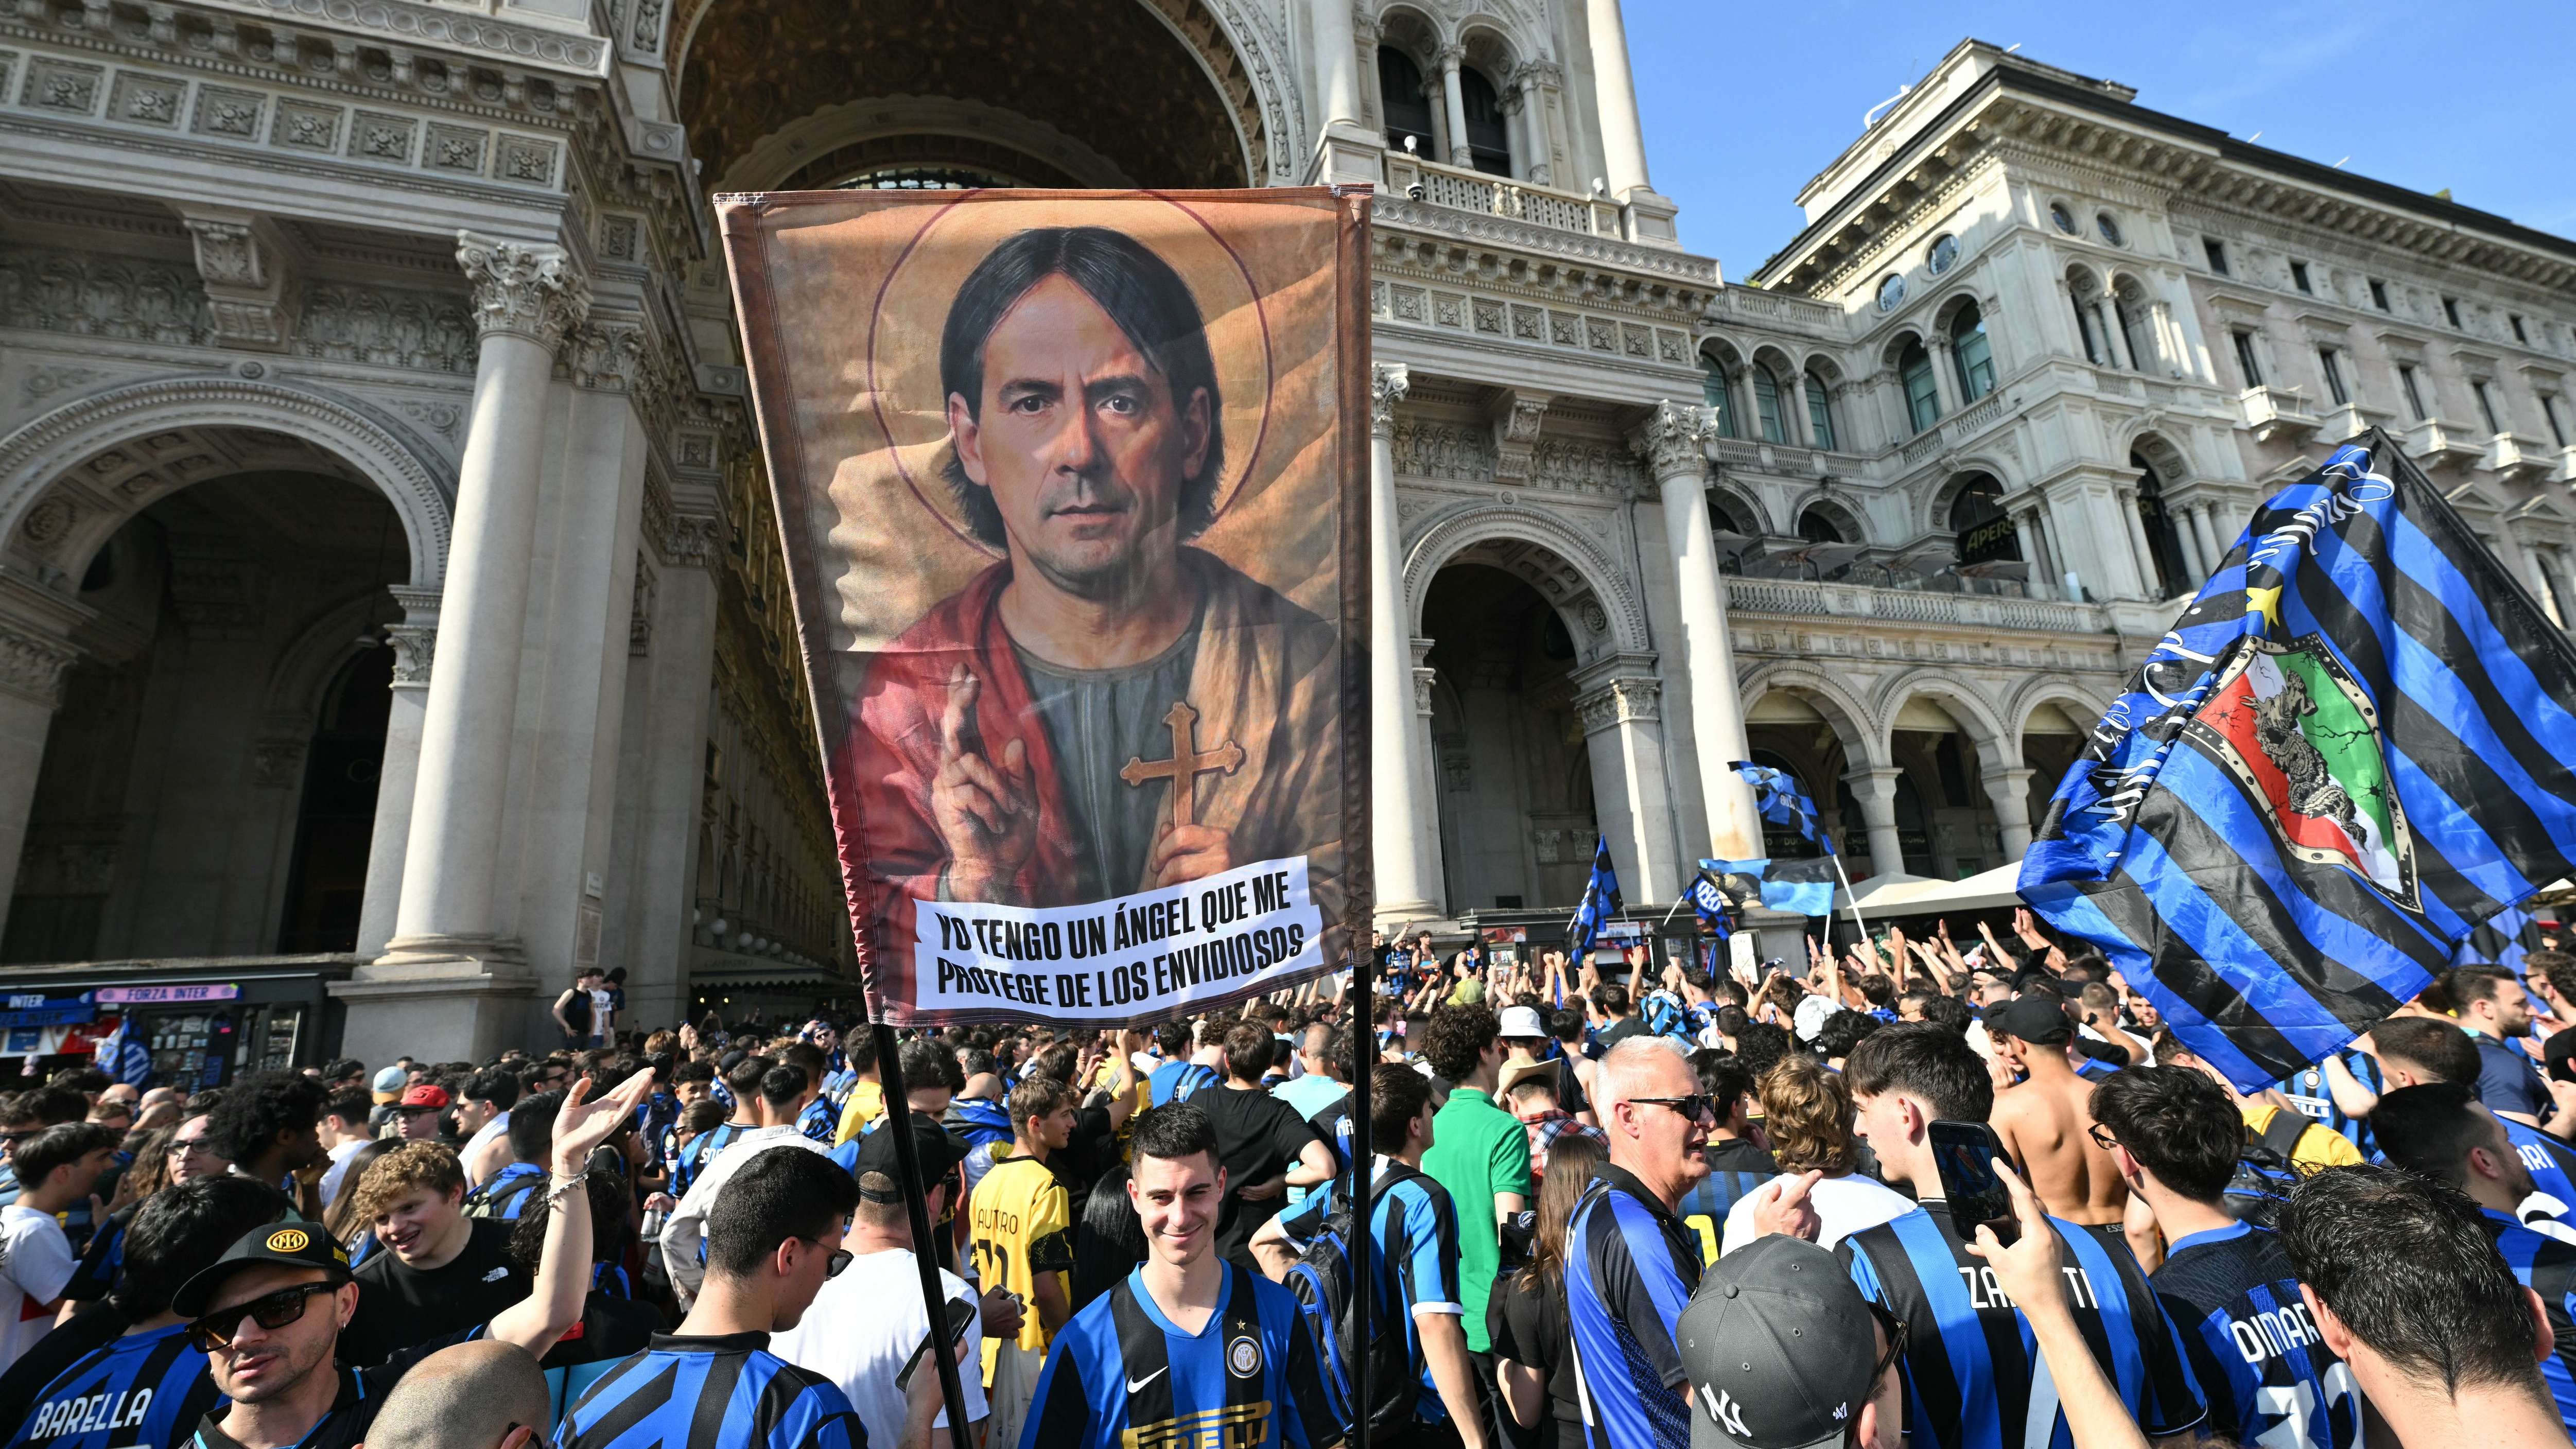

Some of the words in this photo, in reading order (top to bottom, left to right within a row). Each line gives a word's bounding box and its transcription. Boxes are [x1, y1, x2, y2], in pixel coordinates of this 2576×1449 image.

[935, 912, 971, 951] YO
[972, 919, 1062, 960] TENGO
[1068, 916, 1107, 959] UN
[1114, 894, 1195, 951] ÁNGEL
[1202, 881, 1248, 933] QUE
[1253, 871, 1292, 913] ME
[937, 957, 1052, 1005] PROTEGE
[1057, 973, 1092, 1007] DE
[1098, 961, 1148, 1007] LOS
[1154, 923, 1304, 994] ENVIDIOSOS
[8, 994, 45, 1008] INTER
[127, 988, 168, 1001] FORZA
[174, 986, 209, 999] INTER
[1957, 1266, 2099, 1310] ZATI
[30, 1388, 153, 1440] BARELLA
